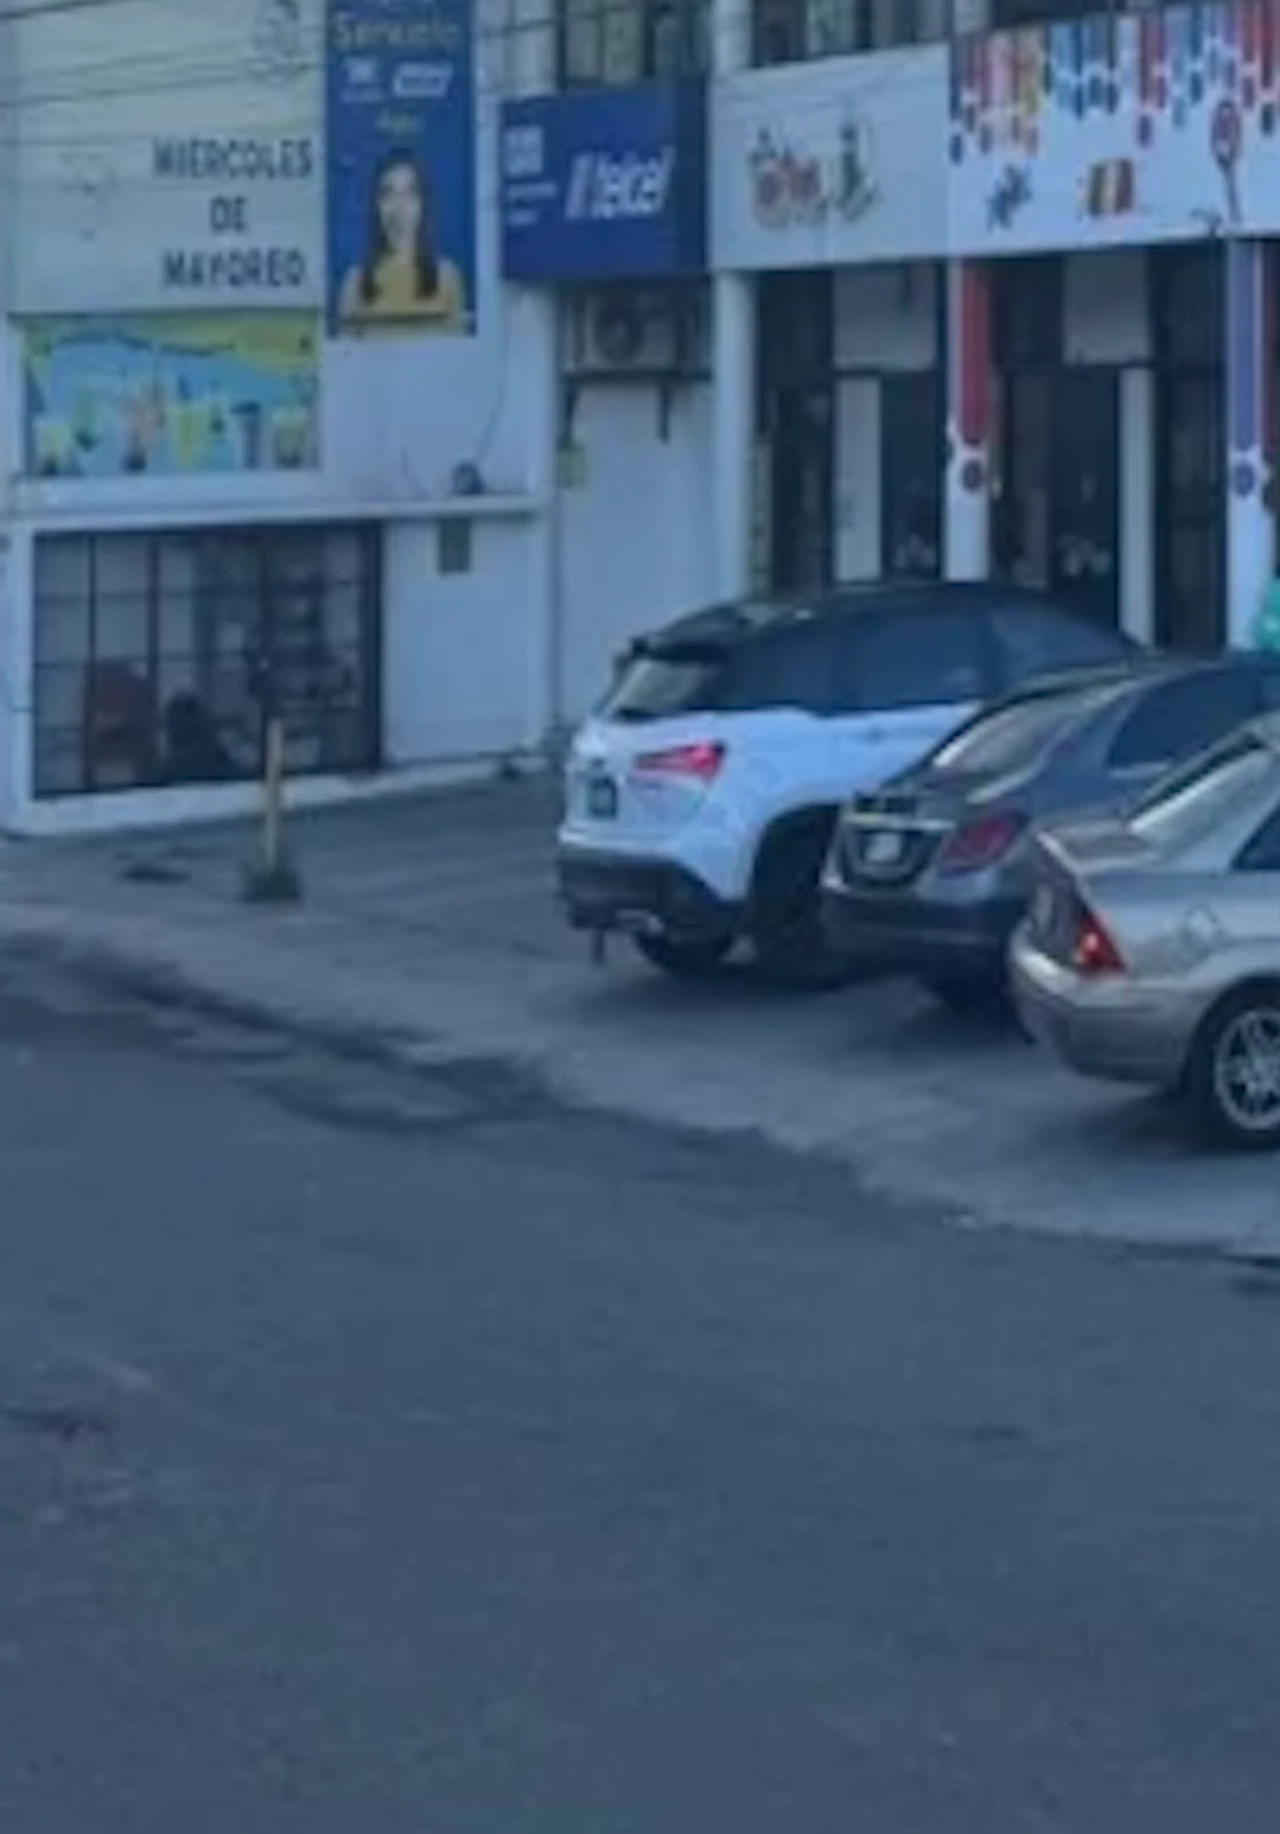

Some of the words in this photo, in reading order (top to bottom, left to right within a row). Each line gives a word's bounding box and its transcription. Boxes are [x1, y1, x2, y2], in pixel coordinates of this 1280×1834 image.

[154, 138, 313, 178] MIERCOLES
[211, 197, 247, 232] DE
[164, 249, 307, 289] MAYOREO
